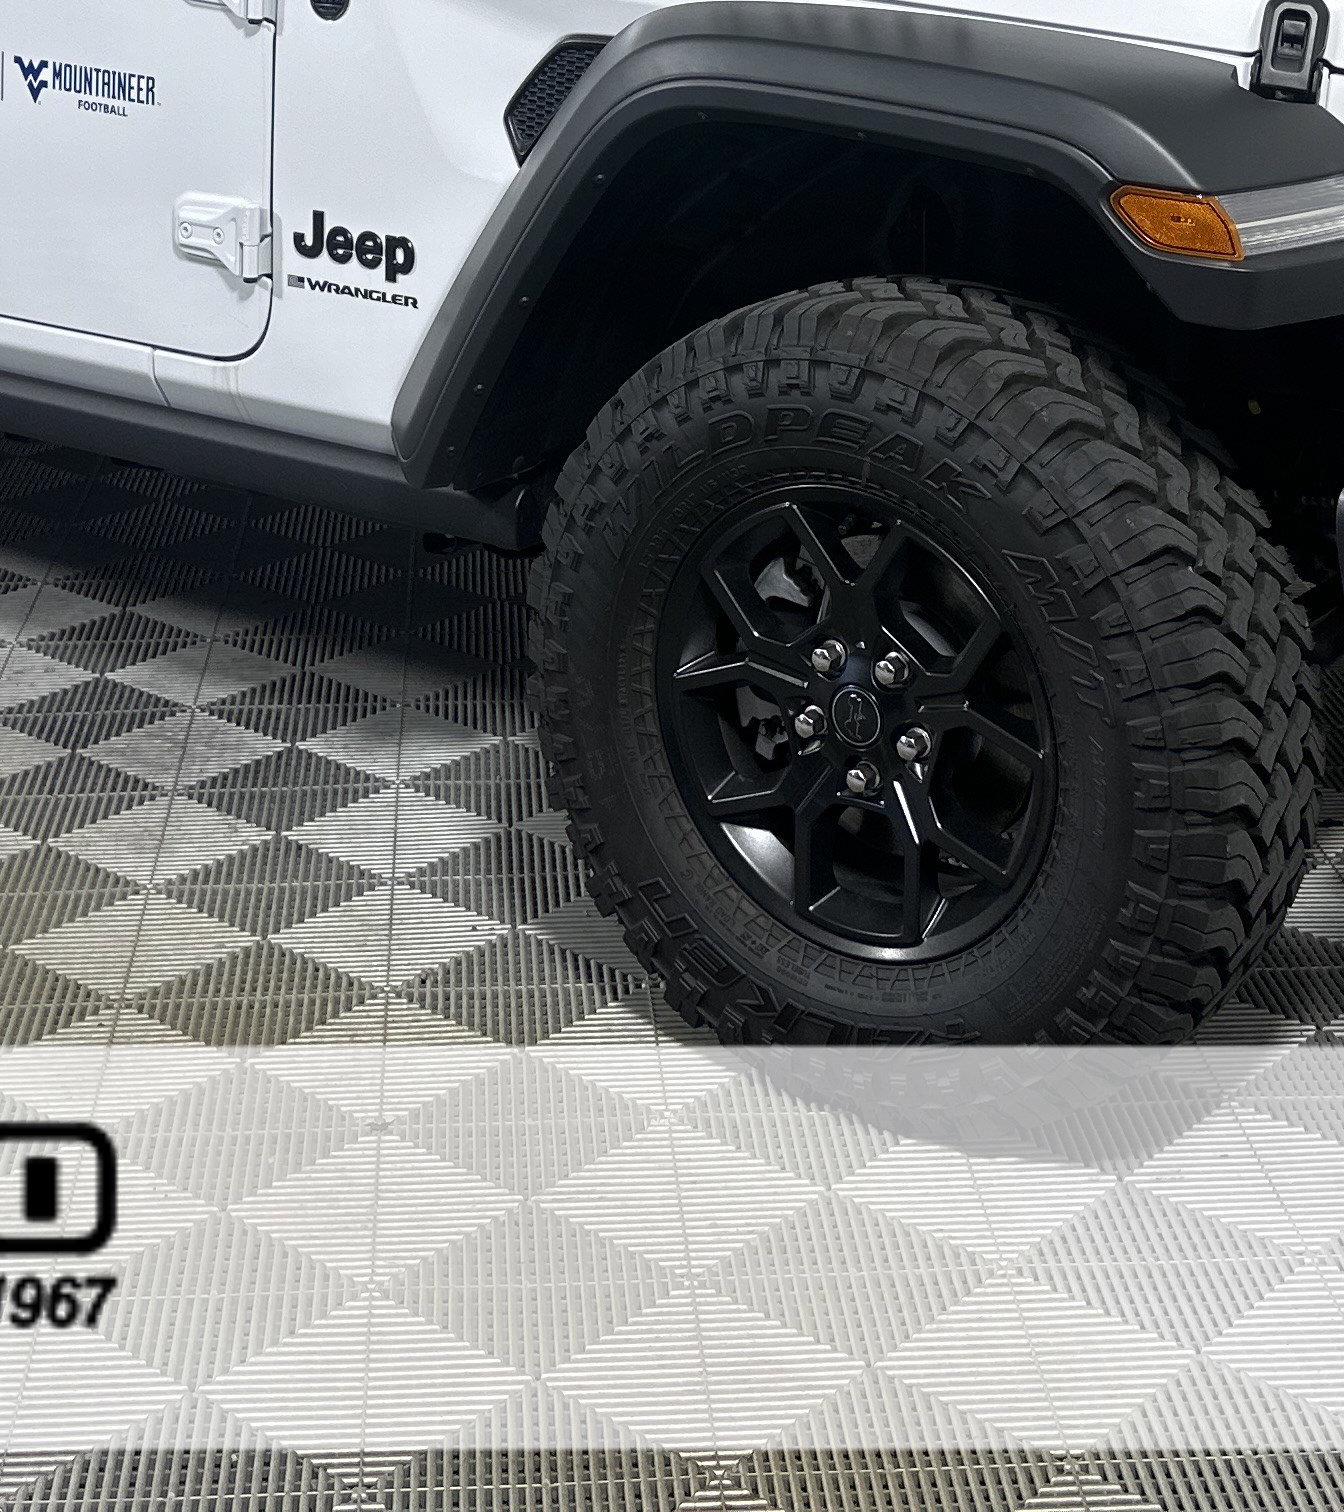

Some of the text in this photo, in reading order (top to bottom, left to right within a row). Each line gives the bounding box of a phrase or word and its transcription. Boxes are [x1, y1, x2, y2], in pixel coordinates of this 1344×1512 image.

[51, 60, 156, 106] MOUNTAINEER
[77, 99, 129, 118] FOOTBALL
[293, 209, 415, 283] Jeep
[306, 277, 419, 310] WRANGLER
[599, 404, 993, 564] WILDPEAK
